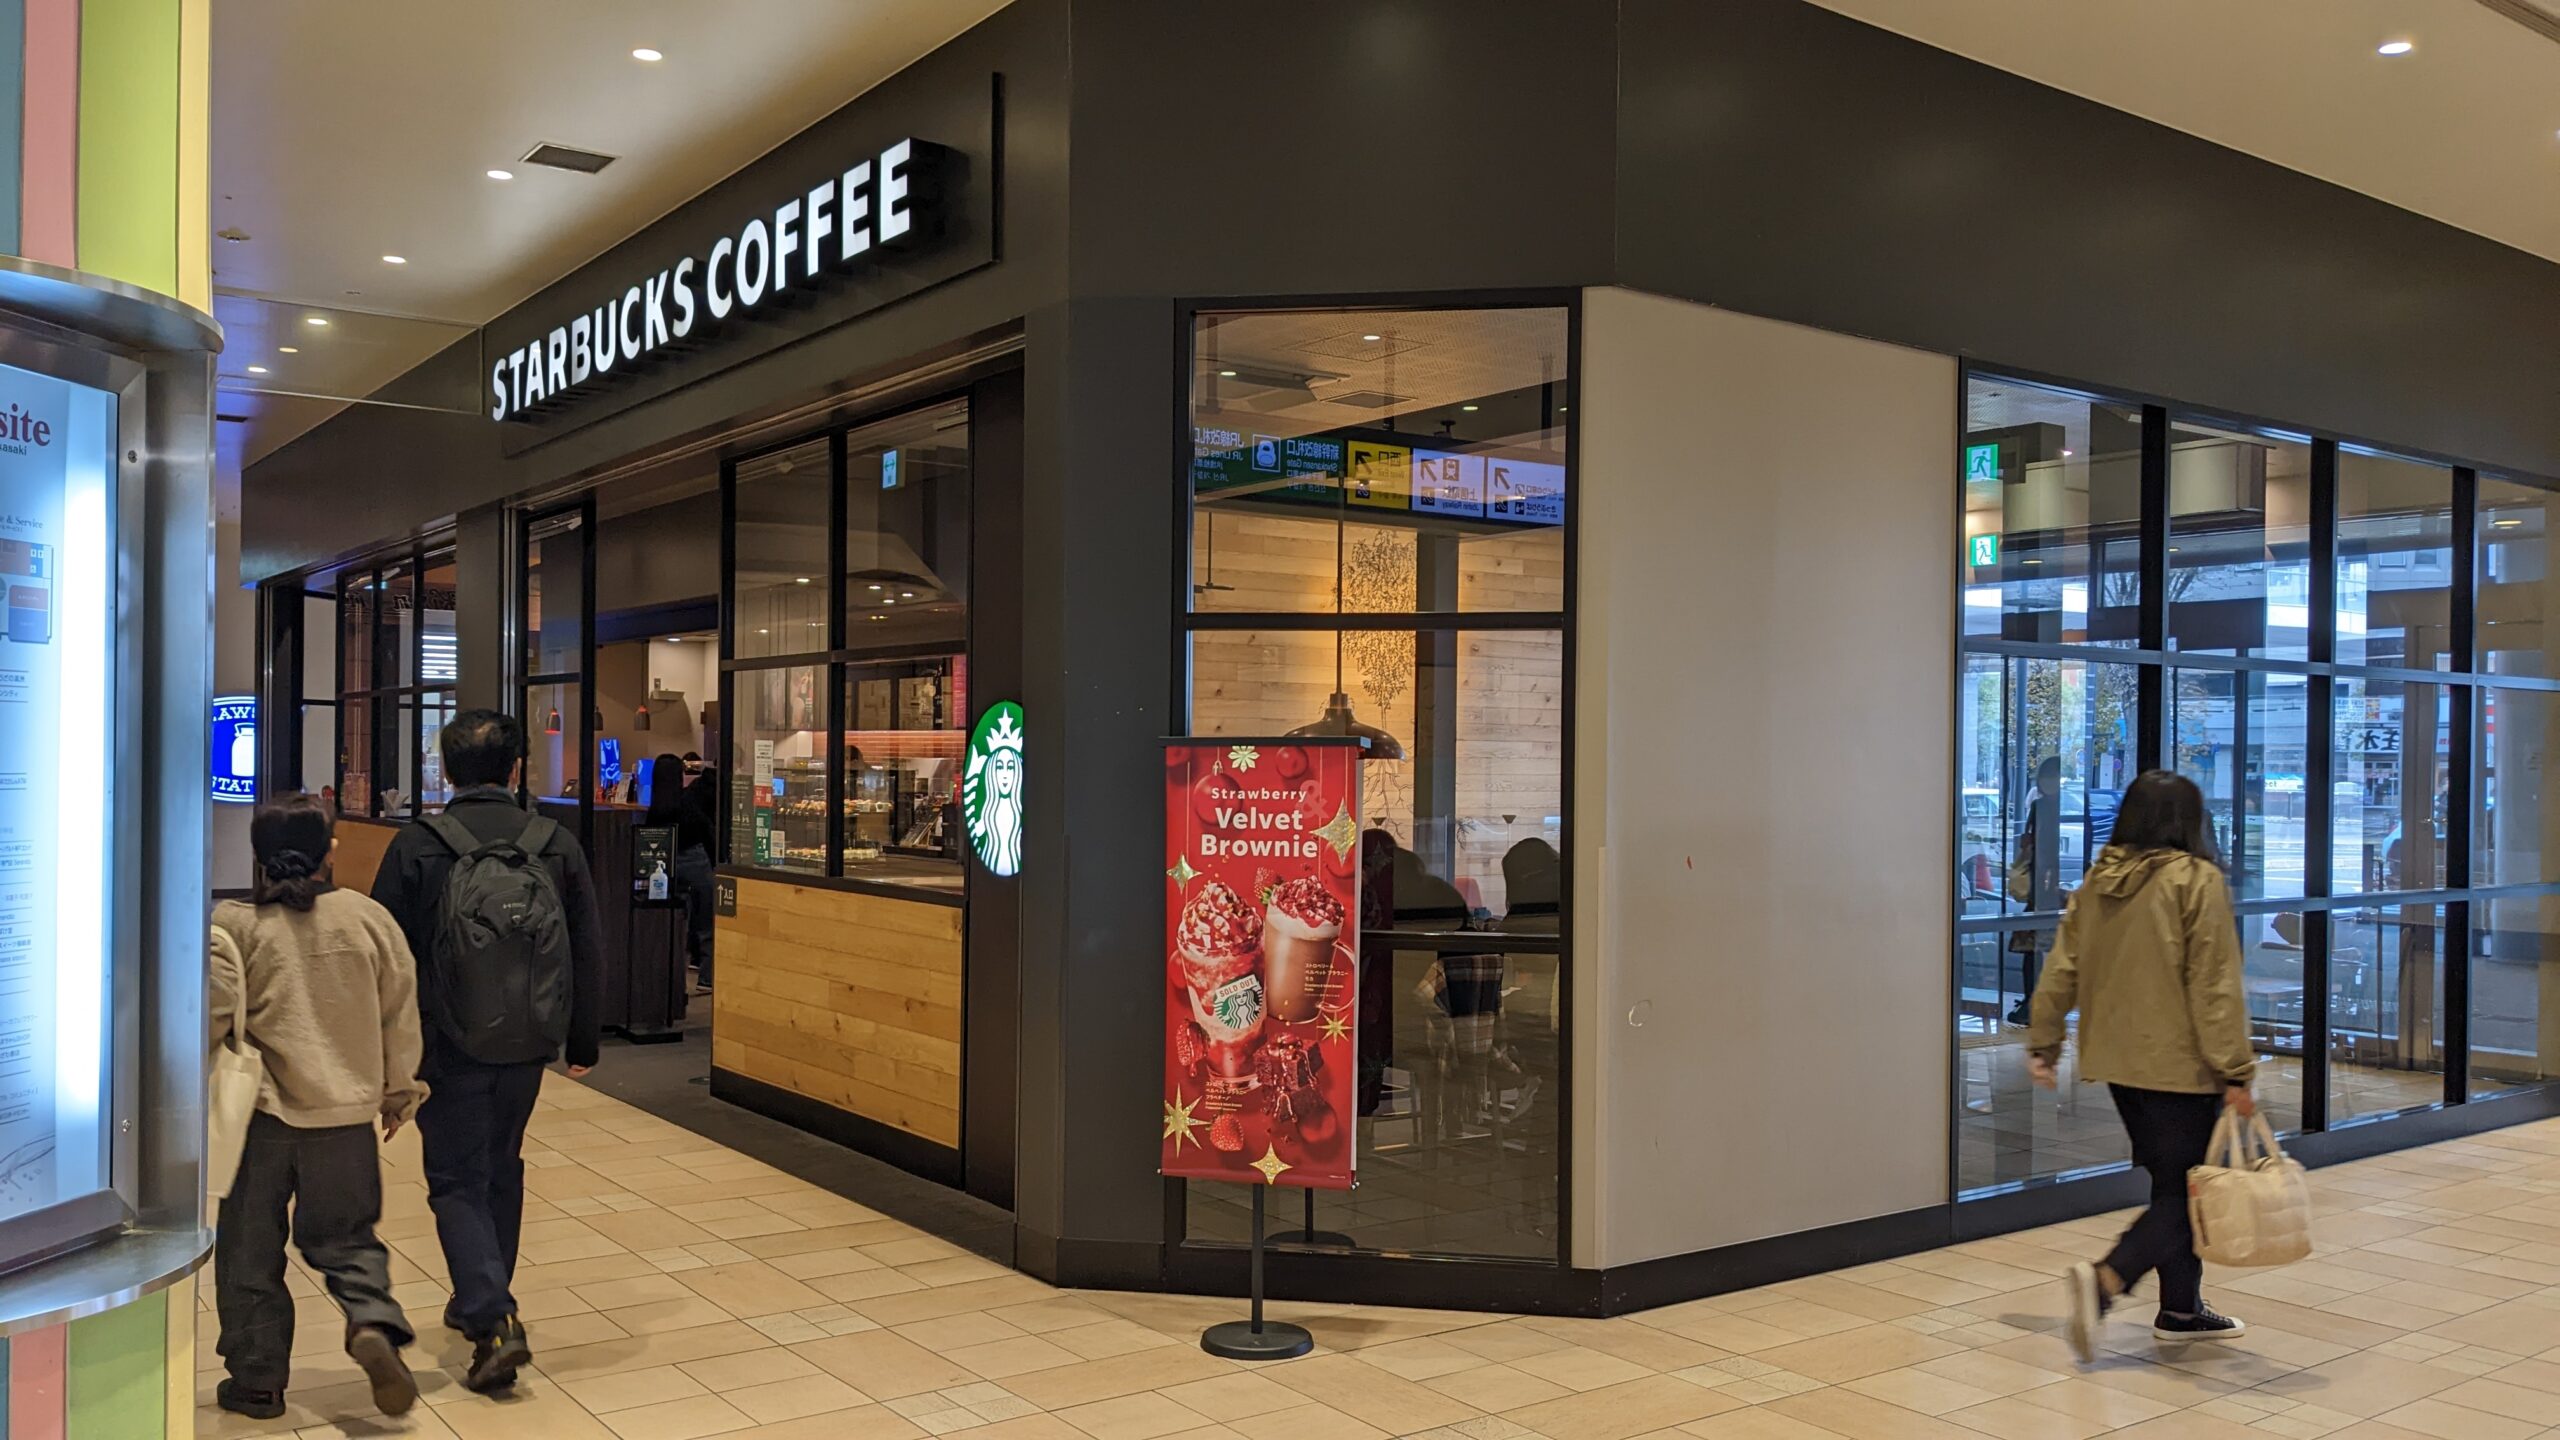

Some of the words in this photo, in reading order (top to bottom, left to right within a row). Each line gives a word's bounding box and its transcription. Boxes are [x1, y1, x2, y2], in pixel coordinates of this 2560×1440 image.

[492, 256, 697, 422] STARBUCKS
[706, 136, 911, 319] COFFEE
[15, 516, 44, 529] Service
[1211, 787, 1307, 803] Strawberry
[1215, 807, 1304, 830] Velvet
[1201, 834, 1318, 858] Brownie
[723, 888, 734, 899] 入口
[1219, 984, 1239, 997] SOLD
[1239, 977, 1254, 989] OUT
